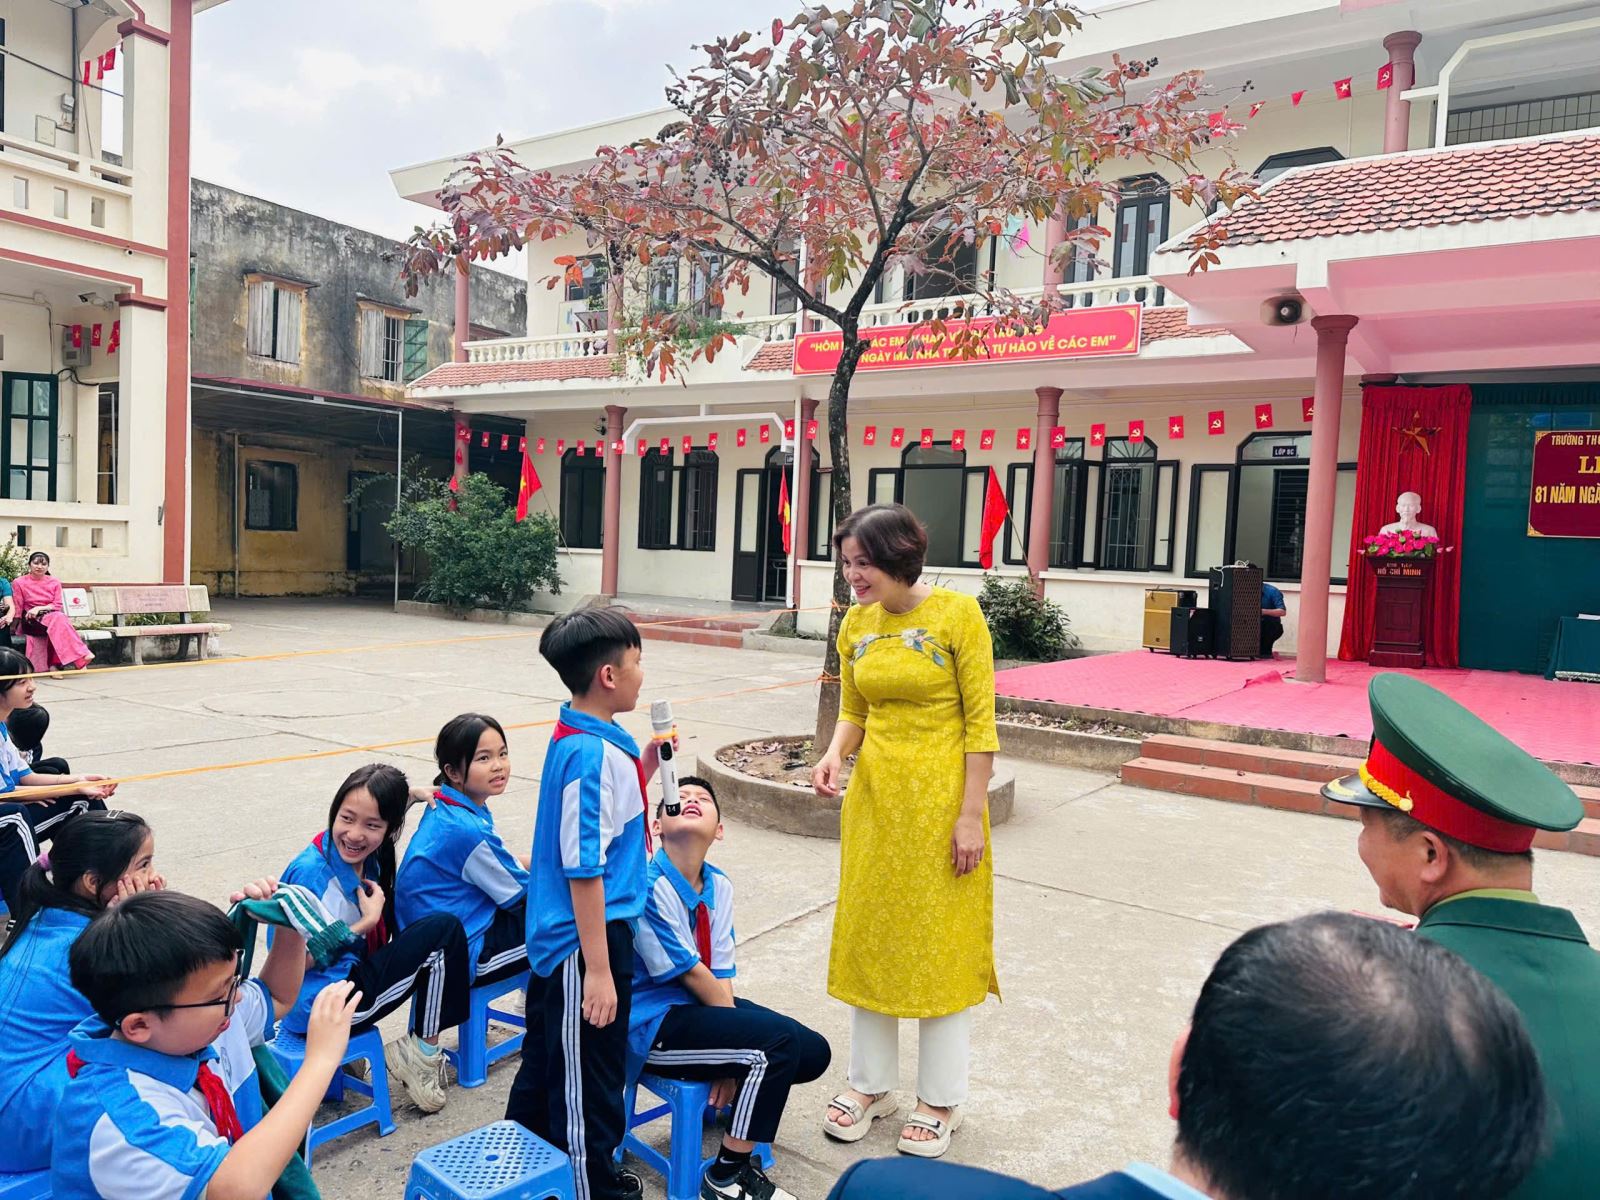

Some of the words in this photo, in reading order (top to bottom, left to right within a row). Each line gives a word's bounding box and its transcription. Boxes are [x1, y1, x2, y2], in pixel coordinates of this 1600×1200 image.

[889, 335, 905, 346] EM
[861, 349, 891, 363] NGÀY
[992, 342, 1007, 356] TỰ
[1009, 339, 1037, 353] HÀO
[1040, 335, 1055, 350] VỀ
[1057, 335, 1088, 349] CÁC
[1551, 432, 1584, 446] TRƯỜNG
[1534, 485, 1548, 503] 81
[1549, 482, 1576, 504] NĂM
[1403, 568, 1421, 576] MINH
